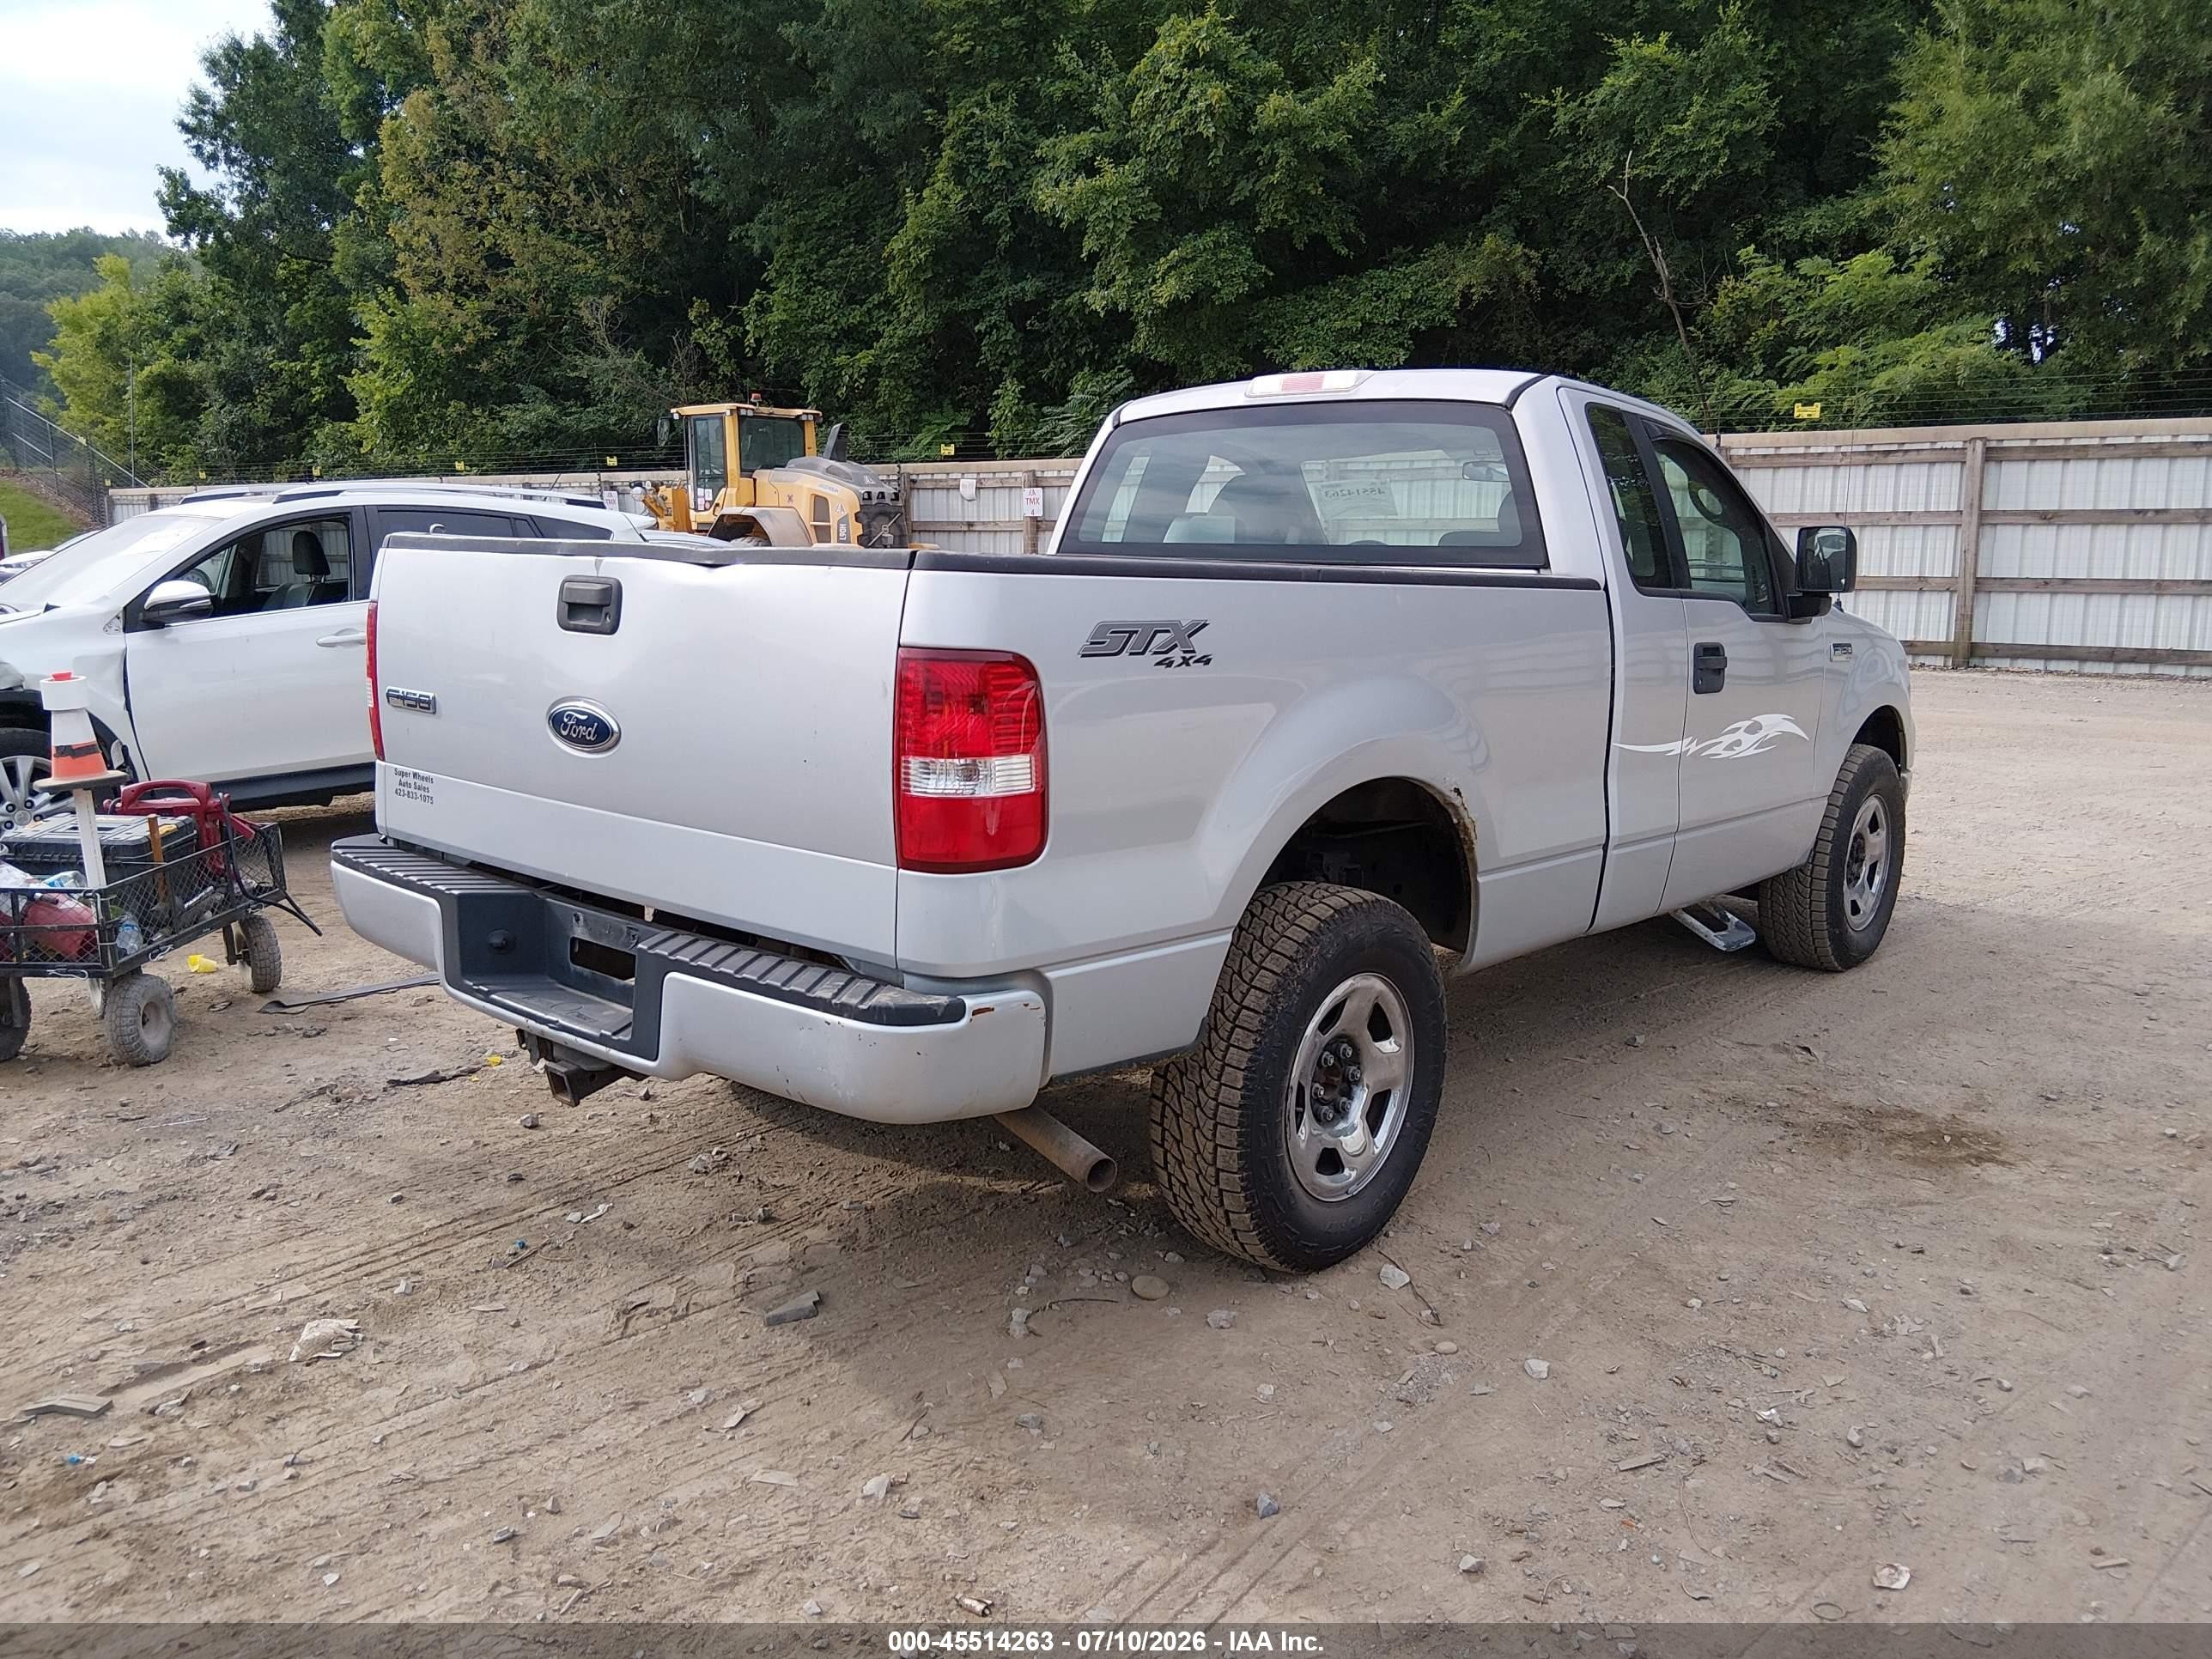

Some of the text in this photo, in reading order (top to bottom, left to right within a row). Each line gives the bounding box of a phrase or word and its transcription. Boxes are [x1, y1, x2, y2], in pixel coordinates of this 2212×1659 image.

[1079, 619, 1210, 658] STX
[560, 711, 599, 741] Ford
[394, 768, 434, 784] Super Wheels
[398, 778, 429, 793] Auto Sales
